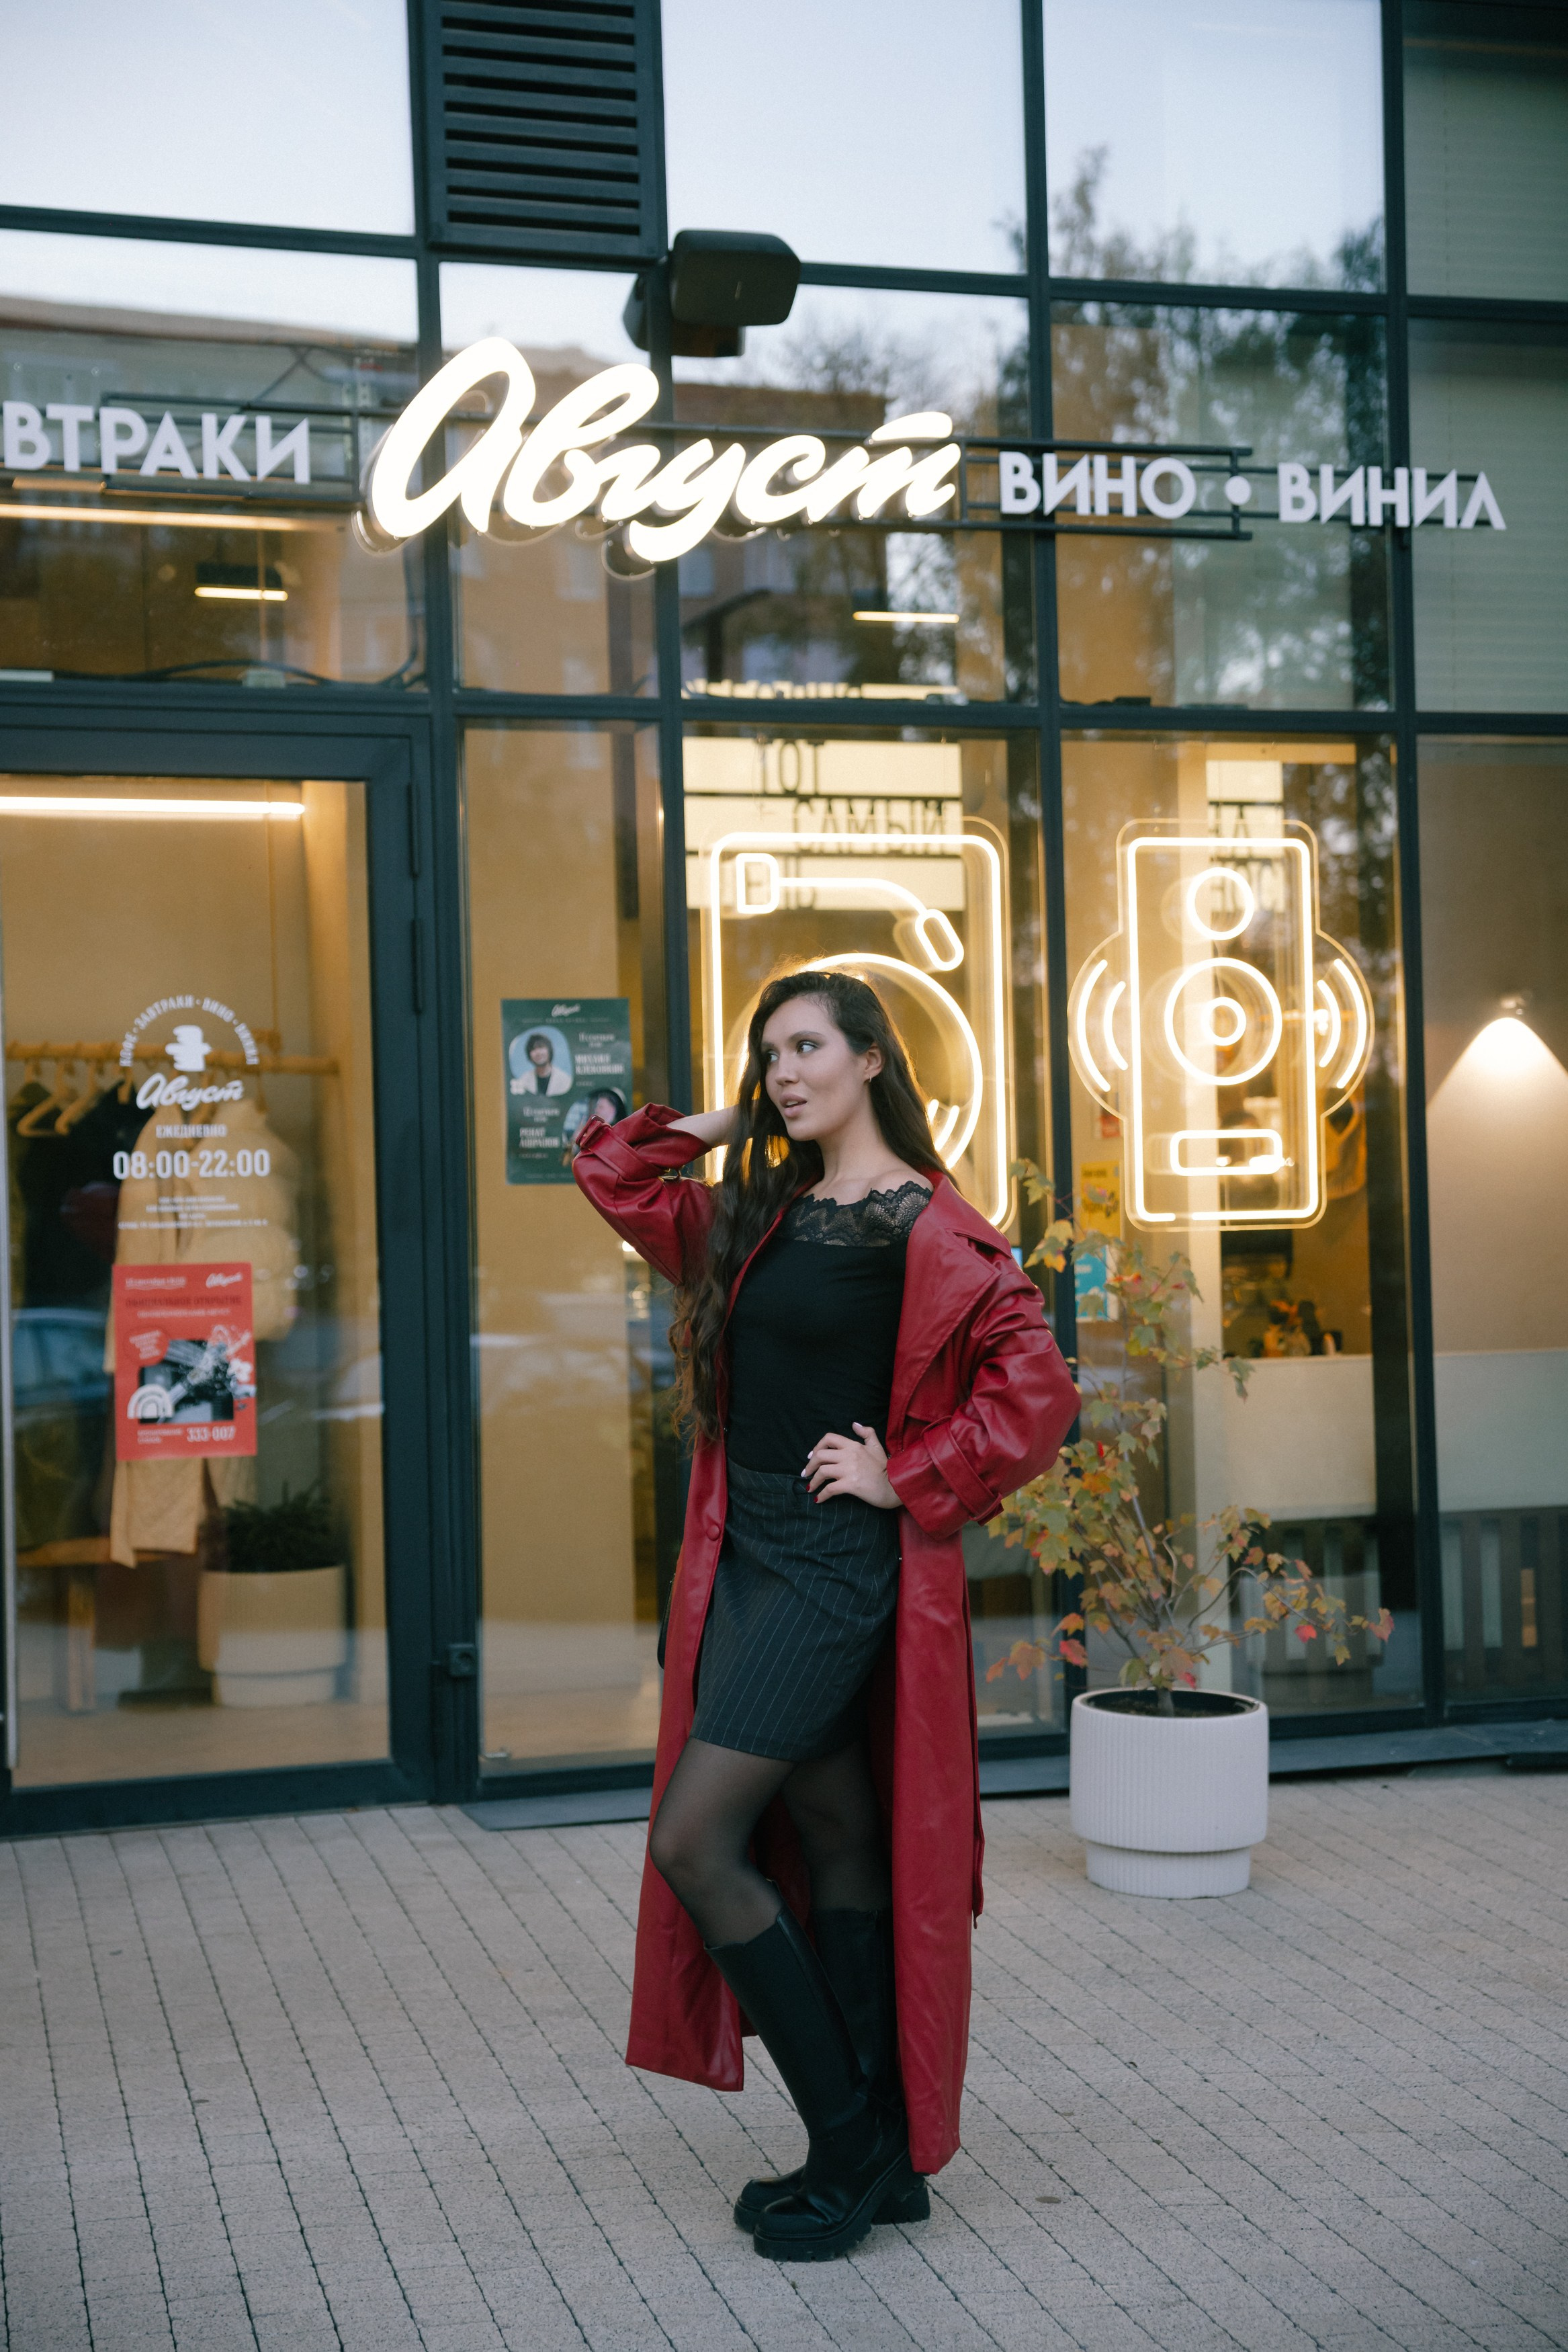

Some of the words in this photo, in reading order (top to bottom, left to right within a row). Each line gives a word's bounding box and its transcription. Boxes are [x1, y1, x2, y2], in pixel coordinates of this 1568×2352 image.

[3, 401, 311, 484] ВТРАКИ
[372, 337, 961, 562] Август
[1000, 451, 1196, 519] ВИНО
[1278, 462, 1506, 530] ВИНИЛ
[136, 1073, 245, 1111] Август
[112, 1149, 269, 1179] 08:00-22:00
